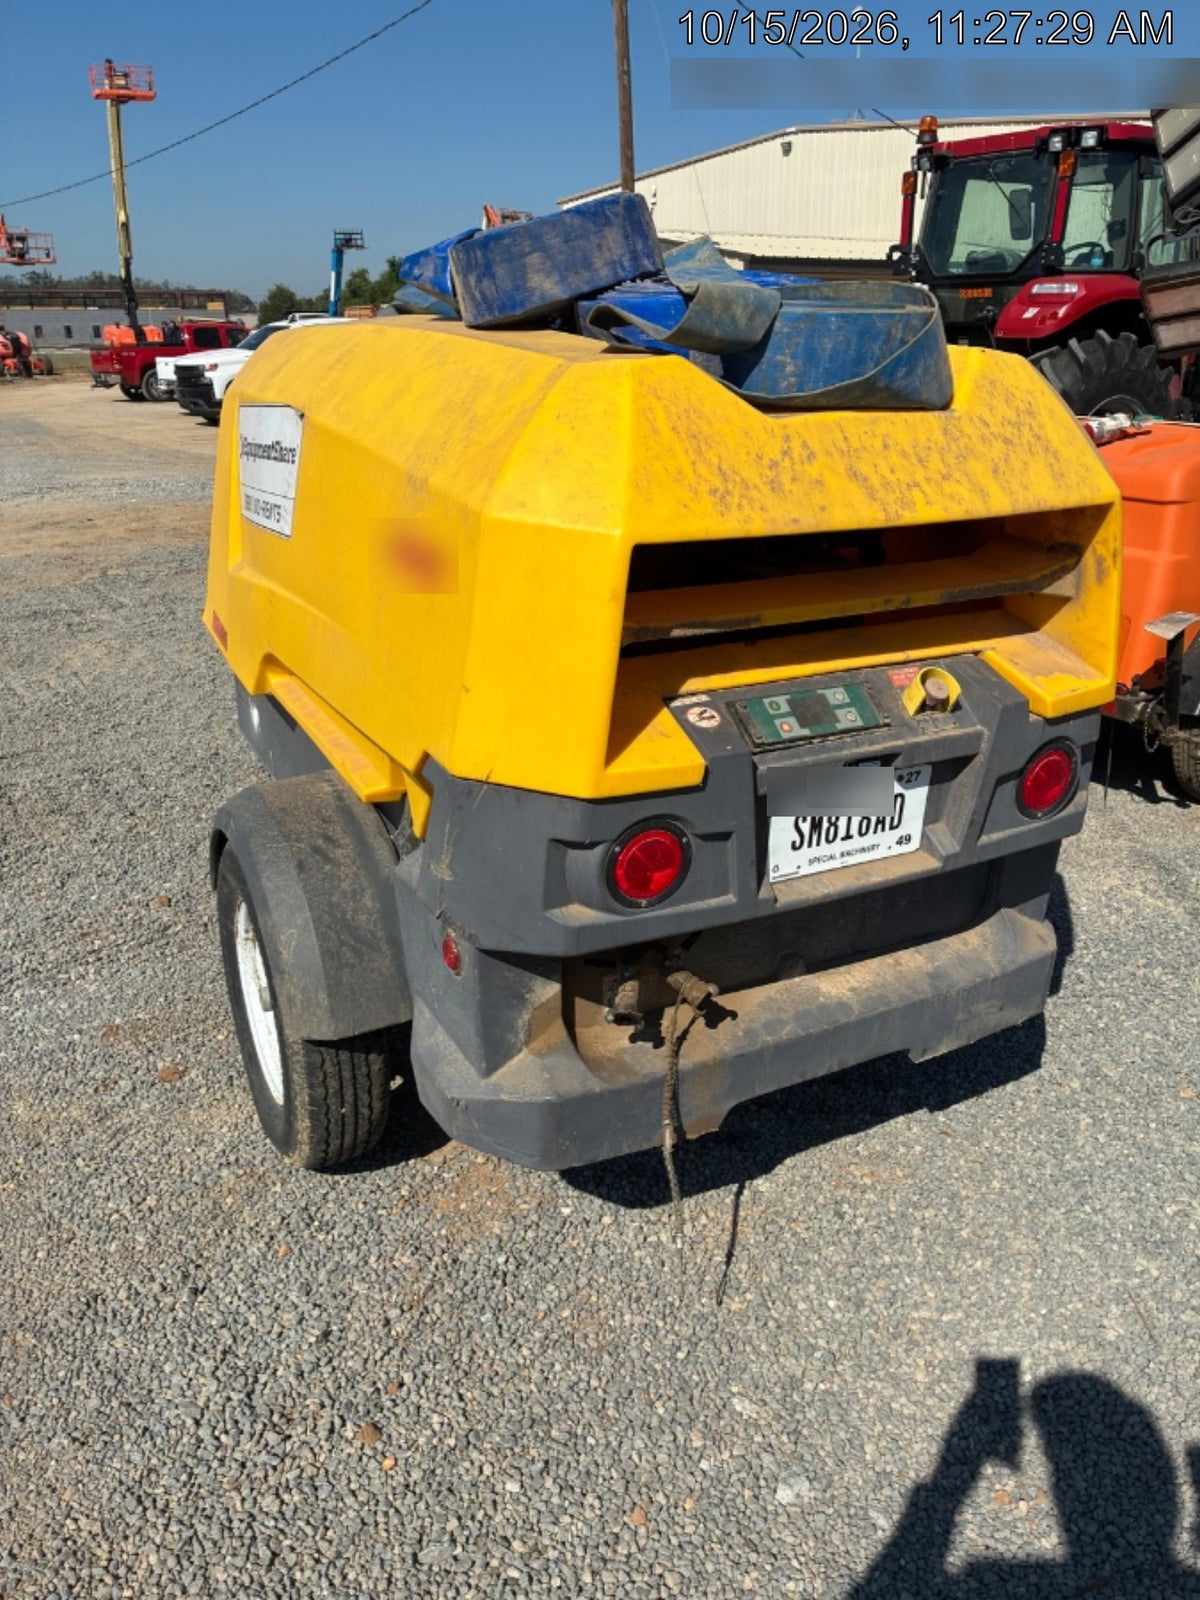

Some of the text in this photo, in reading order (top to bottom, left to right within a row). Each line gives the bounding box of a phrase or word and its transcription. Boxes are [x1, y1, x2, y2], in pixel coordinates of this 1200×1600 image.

[905, 770, 921, 783] 27
[896, 834, 911, 846] 49
[808, 843, 880, 866] SPECIAL MACHINERY
